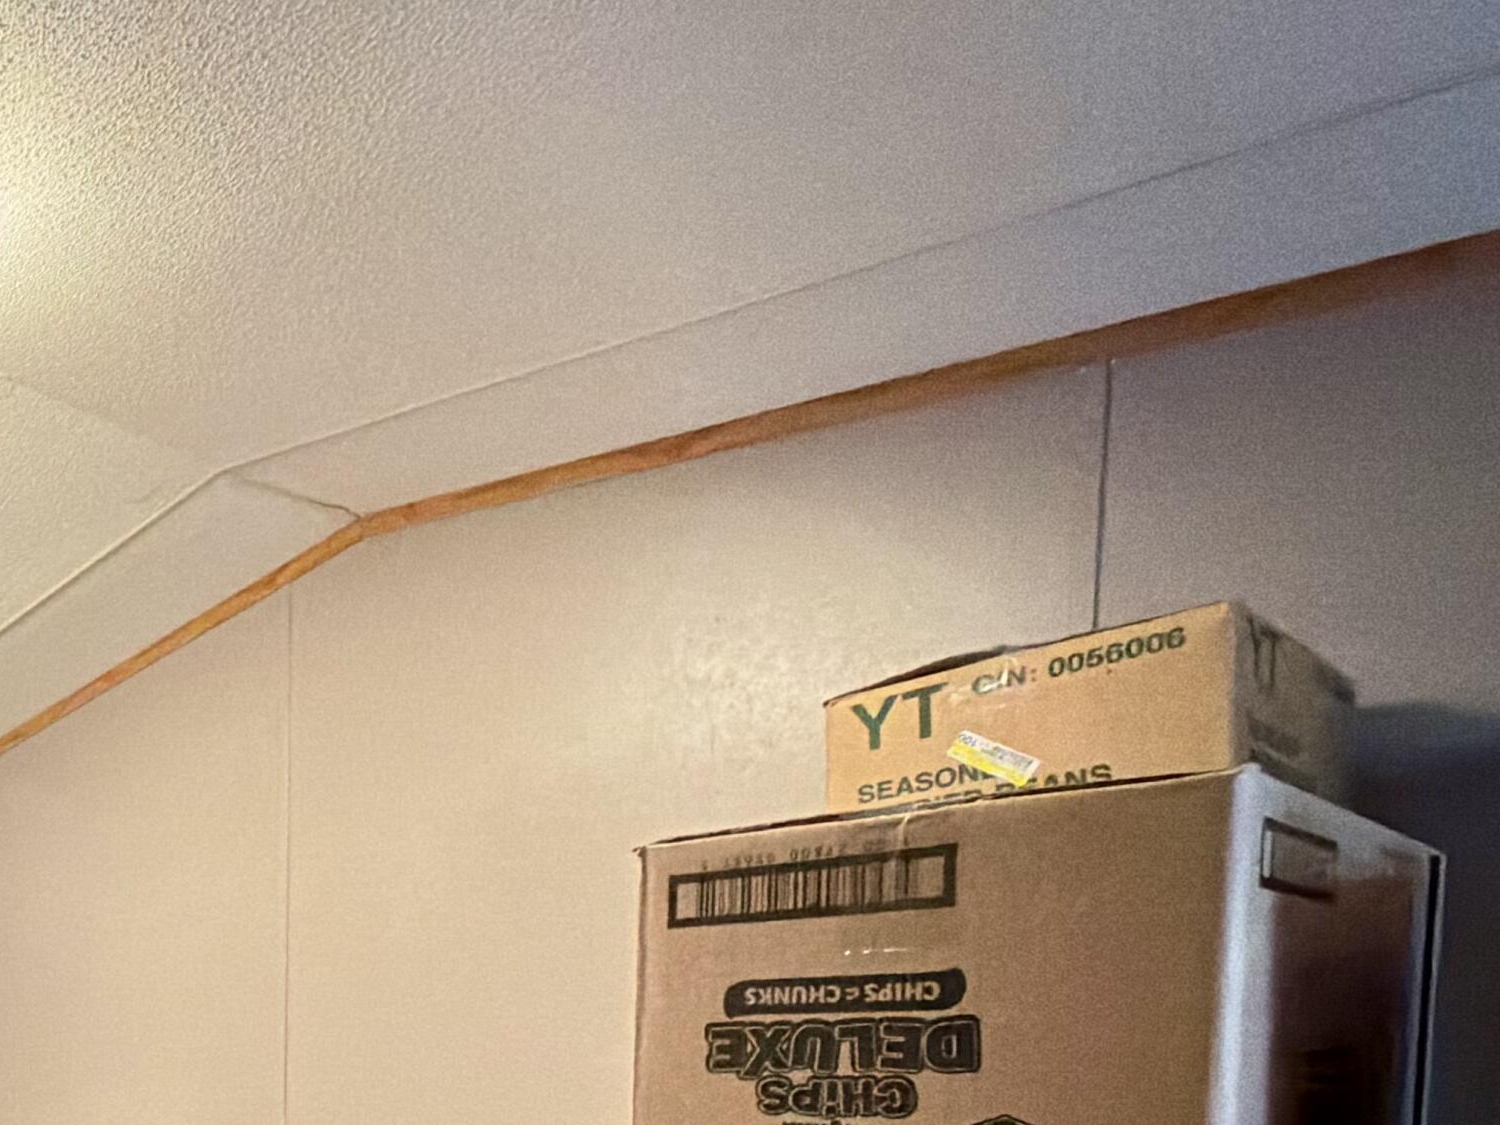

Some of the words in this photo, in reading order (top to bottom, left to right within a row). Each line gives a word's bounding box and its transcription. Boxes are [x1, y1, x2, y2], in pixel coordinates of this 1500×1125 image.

[852, 682, 949, 751] YT
[1048, 627, 1187, 679] 0056006
[858, 763, 998, 804] SEASON
[744, 986, 842, 1007] CHUNKS
[864, 980, 941, 1002] CHIPS
[705, 1014, 982, 1081] DELUXE
